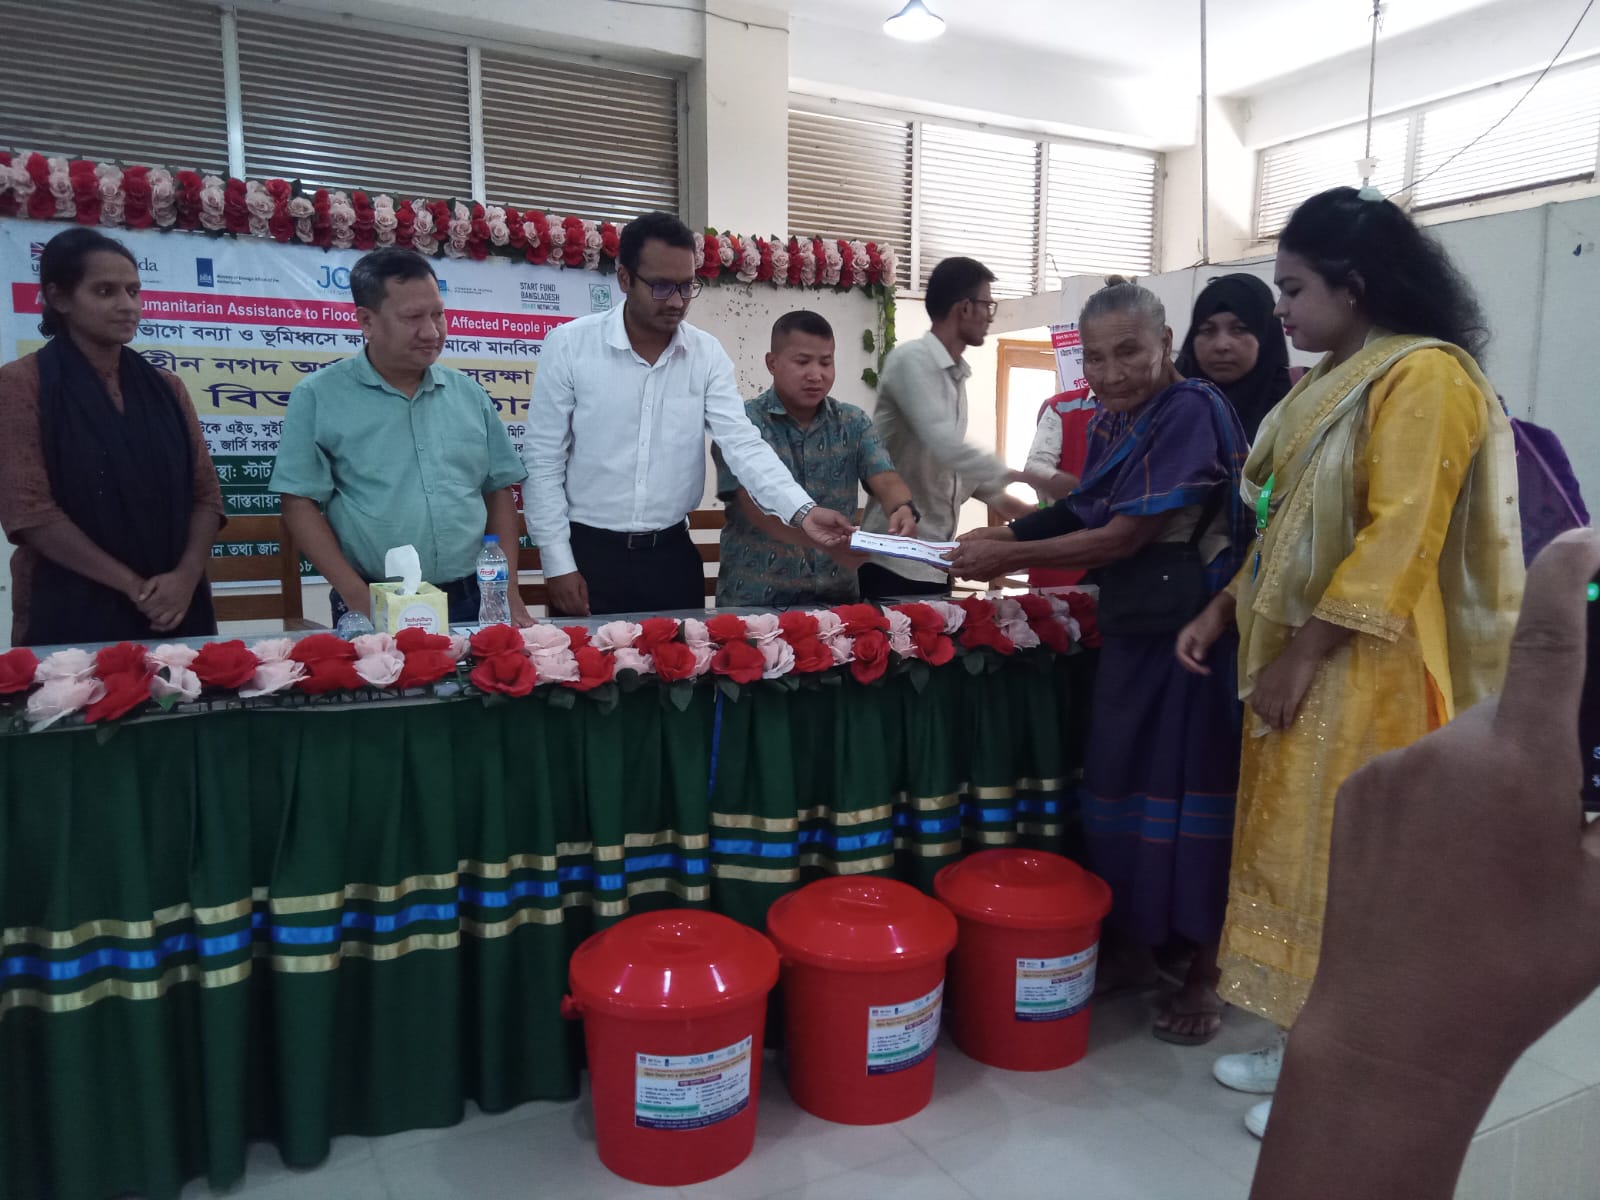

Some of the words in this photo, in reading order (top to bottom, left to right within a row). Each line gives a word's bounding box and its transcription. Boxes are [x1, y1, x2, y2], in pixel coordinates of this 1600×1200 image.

[519, 282, 538, 291] START
[540, 284, 556, 292] FUND
[520, 291, 560, 302] BANGLADESH
[141, 300, 223, 315] umanitarian
[227, 302, 302, 319] Assistance
[305, 307, 318, 320] to
[451, 316, 499, 331] Affected
[502, 318, 540, 335] People
[189, 326, 232, 342] বন্যা
[238, 330, 253, 340] ও
[485, 339, 542, 356] মানবিক
[211, 356, 283, 376] নগদ
[219, 436, 248, 452] জার্সি
[241, 460, 273, 479] স্টার্ট
[227, 543, 254, 556] তথ্য
[480, 568, 497, 576] Fresh
